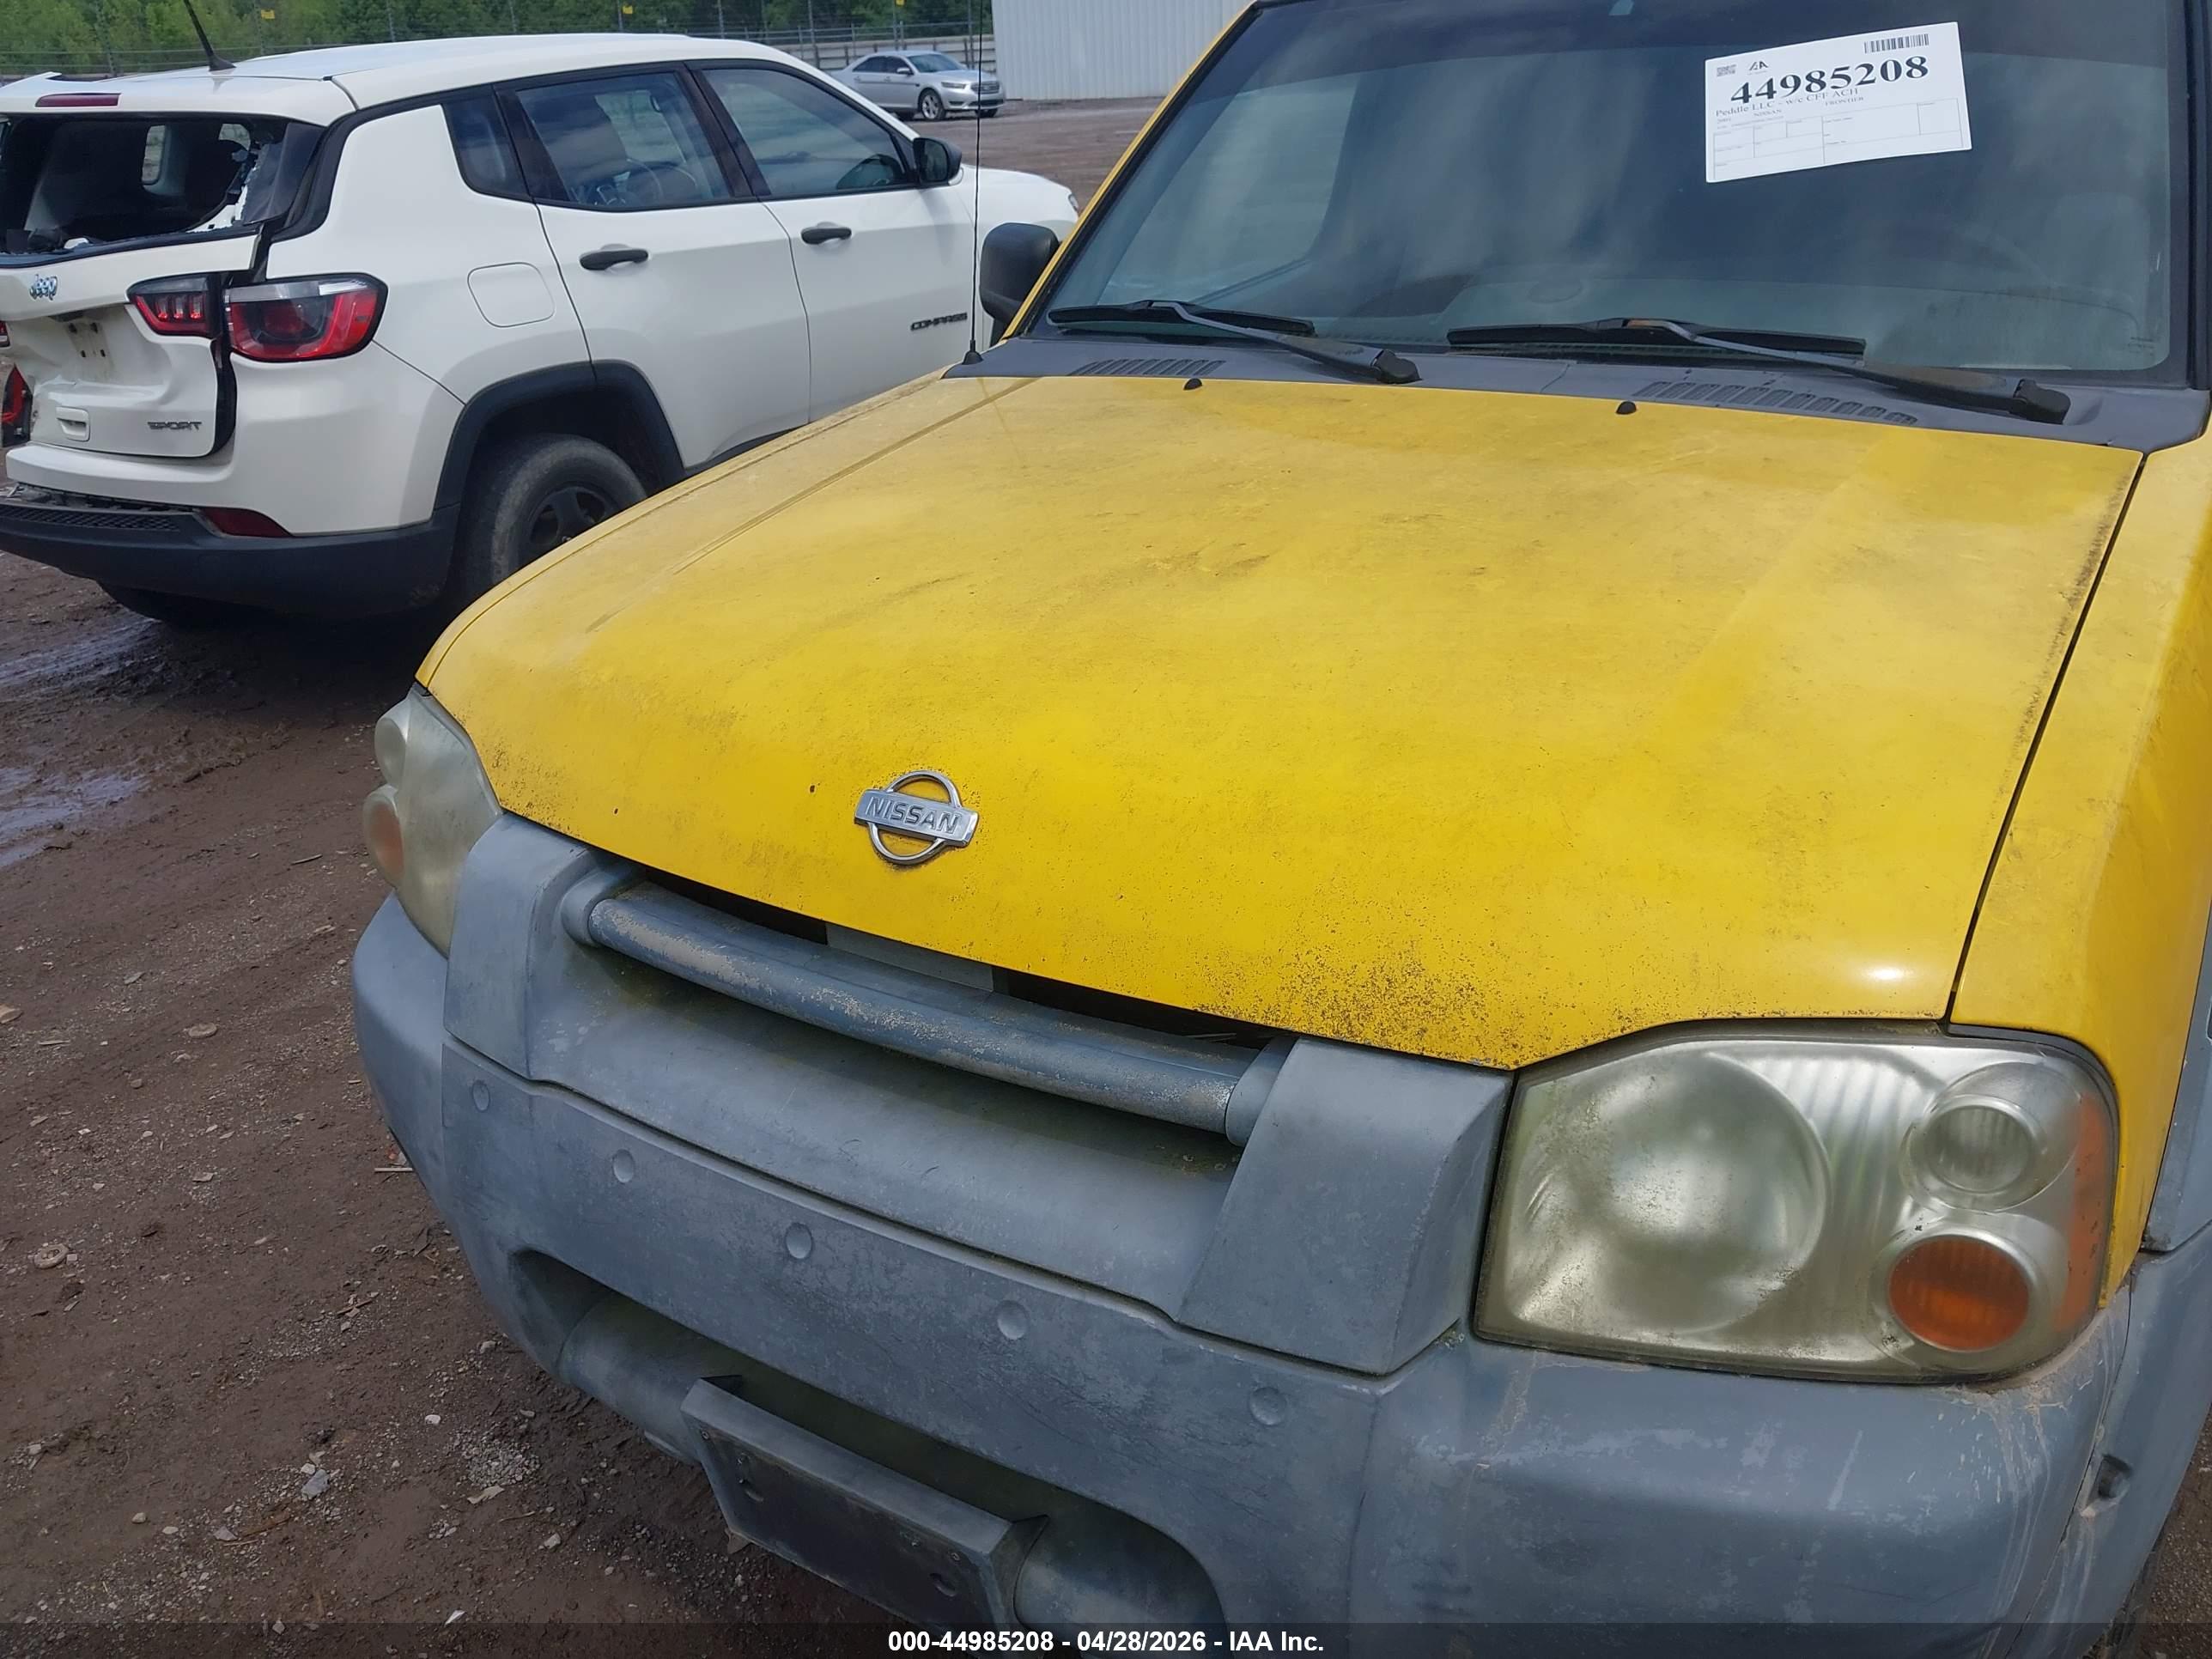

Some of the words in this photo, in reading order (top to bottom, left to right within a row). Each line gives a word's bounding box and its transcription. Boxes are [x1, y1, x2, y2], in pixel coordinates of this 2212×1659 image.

[1730, 56, 1929, 104] 44985208
[147, 421, 203, 431] SPORT
[865, 795, 963, 835] NISSAN
